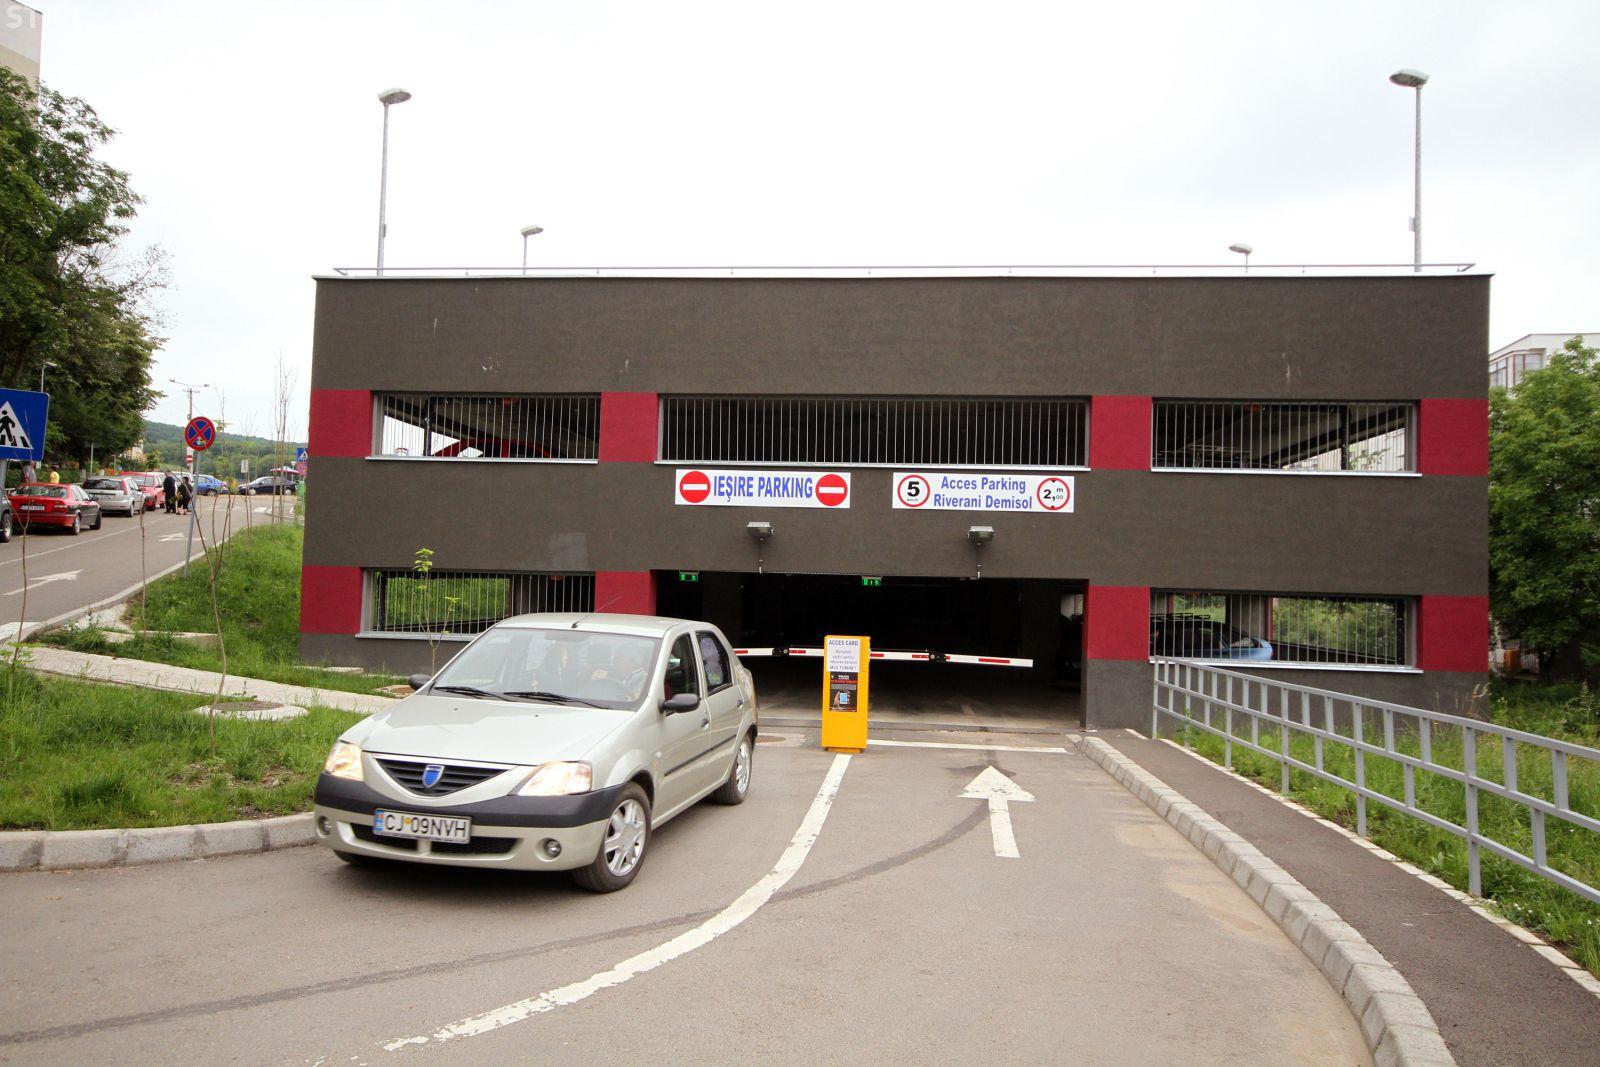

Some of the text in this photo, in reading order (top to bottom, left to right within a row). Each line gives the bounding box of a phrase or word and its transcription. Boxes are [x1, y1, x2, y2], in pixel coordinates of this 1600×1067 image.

[757, 477, 813, 498] PARKING
[907, 481, 920, 497] 5
[941, 476, 1026, 494] Acces Parking
[933, 494, 1032, 509] Riverani Demisol
[384, 814, 405, 832] CJ
[410, 817, 467, 838] 09NVH
